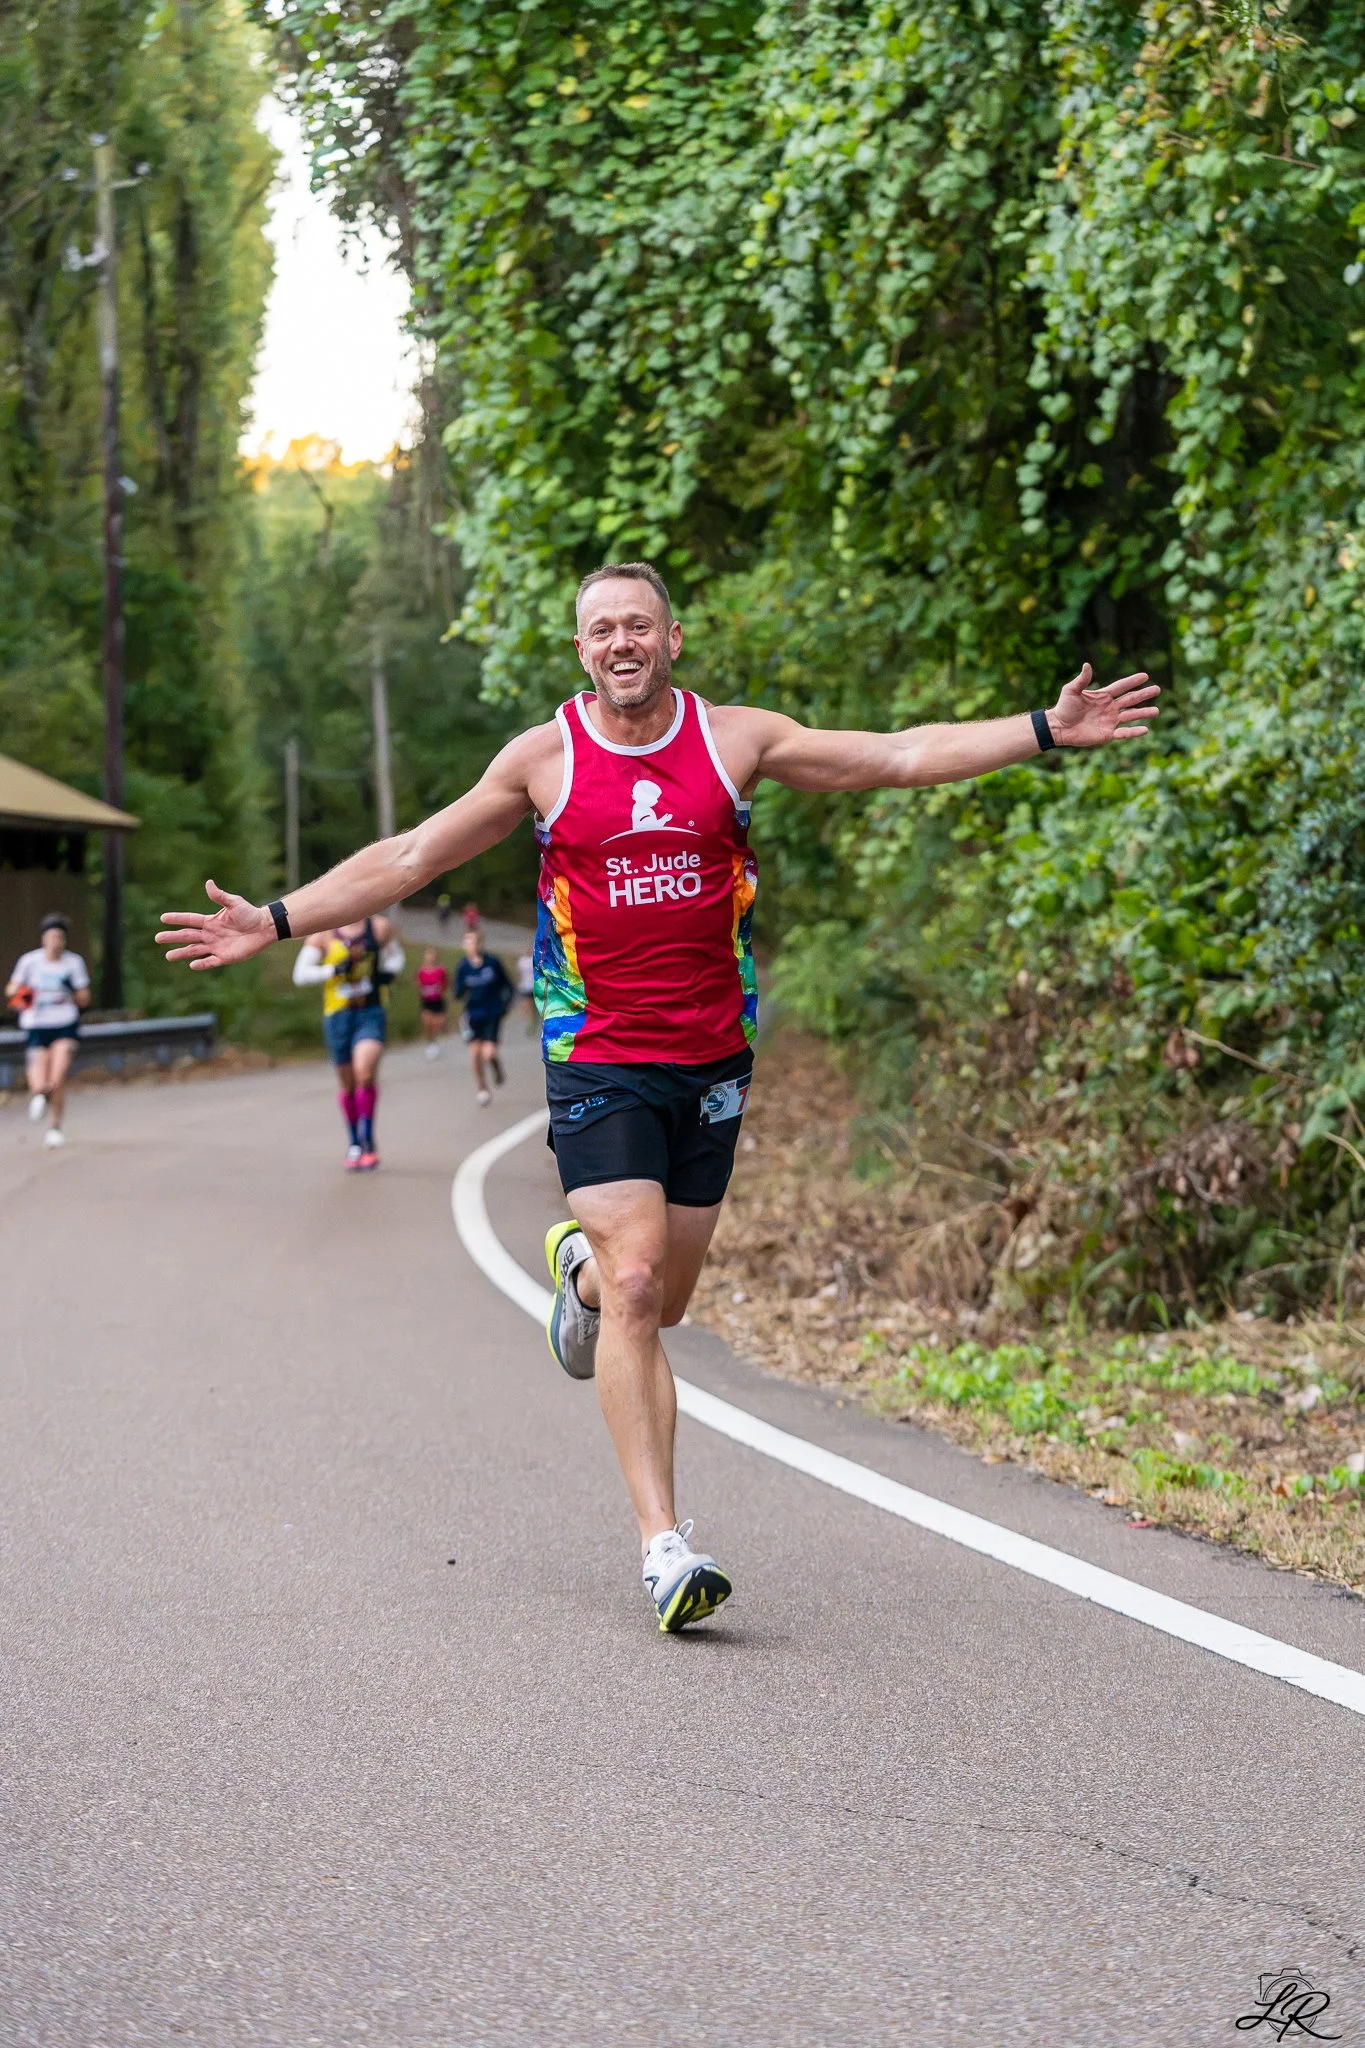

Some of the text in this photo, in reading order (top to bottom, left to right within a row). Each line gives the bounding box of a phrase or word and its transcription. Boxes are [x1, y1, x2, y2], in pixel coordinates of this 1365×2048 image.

[605, 851, 701, 876] St. Jude
[608, 872, 702, 908] HERO
